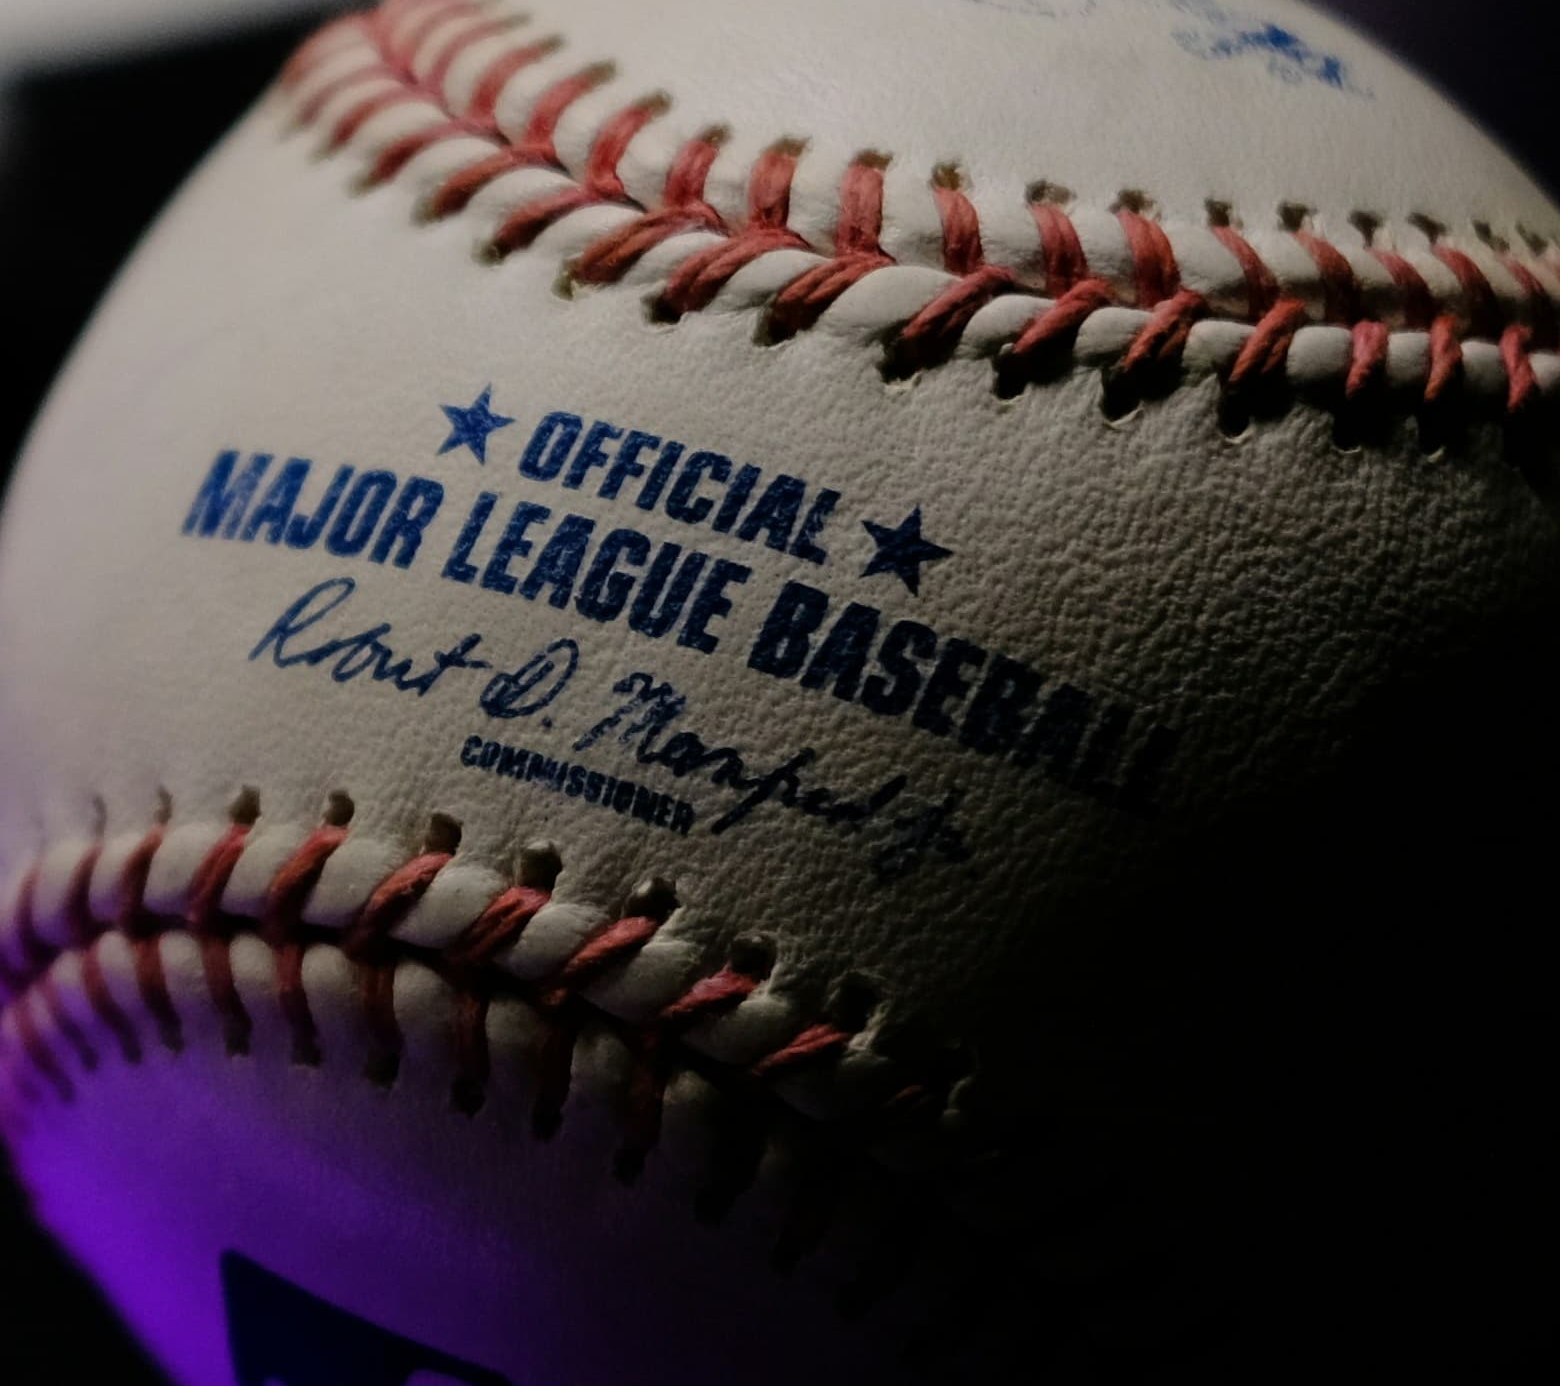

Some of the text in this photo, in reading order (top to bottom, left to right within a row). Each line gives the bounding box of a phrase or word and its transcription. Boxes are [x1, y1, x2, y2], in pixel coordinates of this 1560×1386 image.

[518, 410, 841, 565] OFFICIAL
[181, 449, 1180, 821] MAJOR LEAGUE BASEBALL
[460, 735, 694, 833] COMMISSIONER
